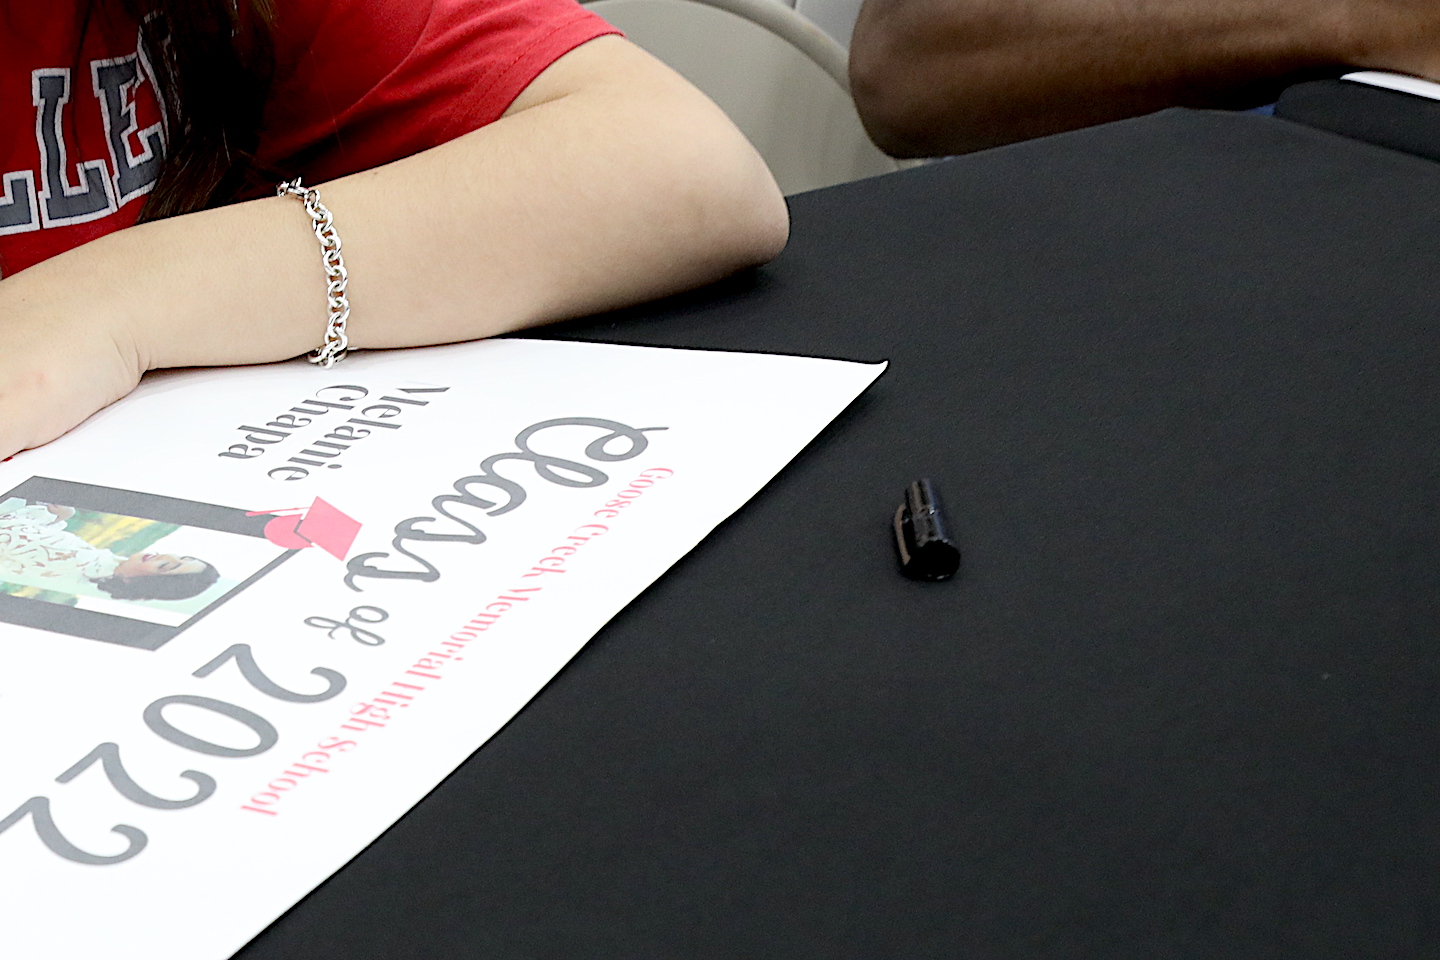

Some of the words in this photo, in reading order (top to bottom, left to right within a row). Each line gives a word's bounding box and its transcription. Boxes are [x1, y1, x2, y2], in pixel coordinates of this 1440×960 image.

[217, 384, 370, 460] Chapa
[266, 385, 452, 481] Melanie
[343, 416, 670, 592] Class
[593, 466, 675, 519] Goose
[520, 523, 609, 579] Creek
[303, 604, 390, 647] of
[405, 586, 543, 680] Memorial
[339, 681, 426, 732] High
[239, 736, 358, 817] School
